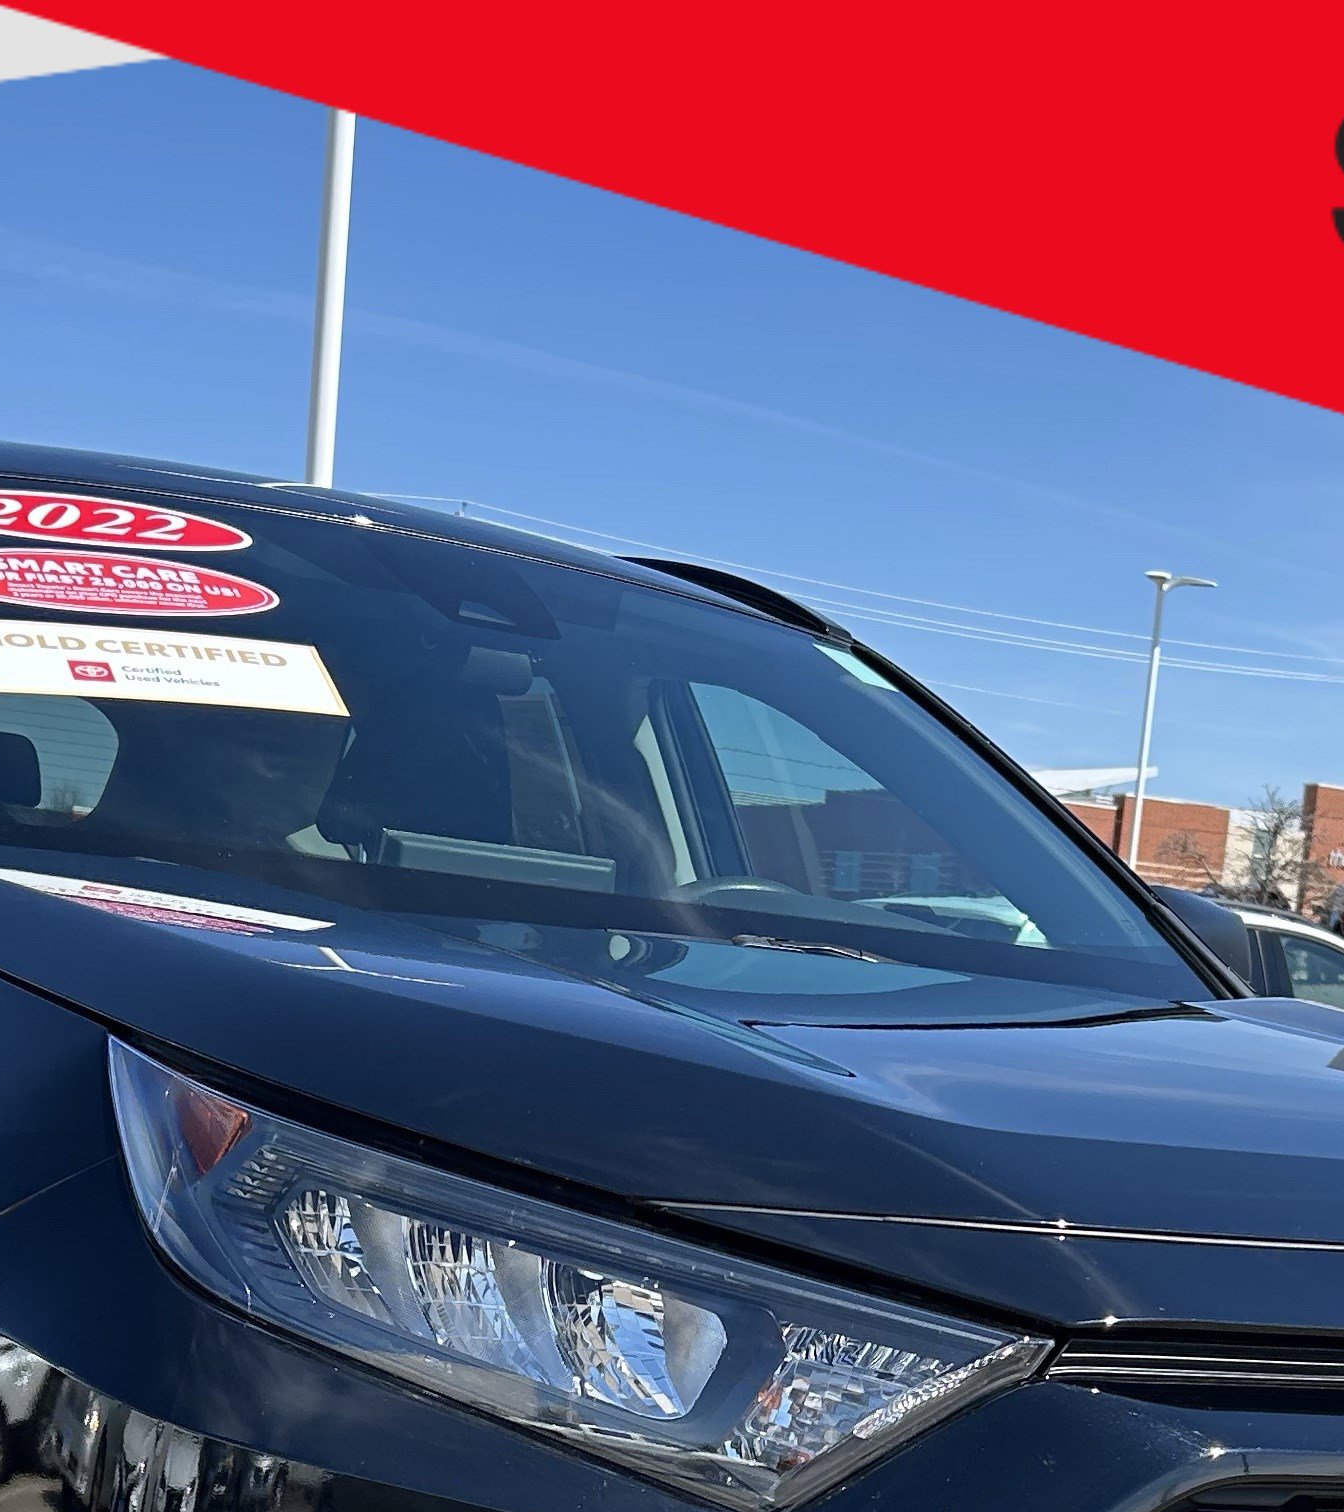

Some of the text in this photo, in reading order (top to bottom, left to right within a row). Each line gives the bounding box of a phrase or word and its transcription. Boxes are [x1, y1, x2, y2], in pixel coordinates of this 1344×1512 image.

[112, 565, 200, 584] CARE
[24, 573, 85, 585] FIRST
[166, 582, 202, 594] ON
[204, 585, 241, 598] US!
[95, 639, 288, 667] CERTIFIED
[122, 665, 181, 676] Certified
[126, 674, 220, 687] Used Vehicles
